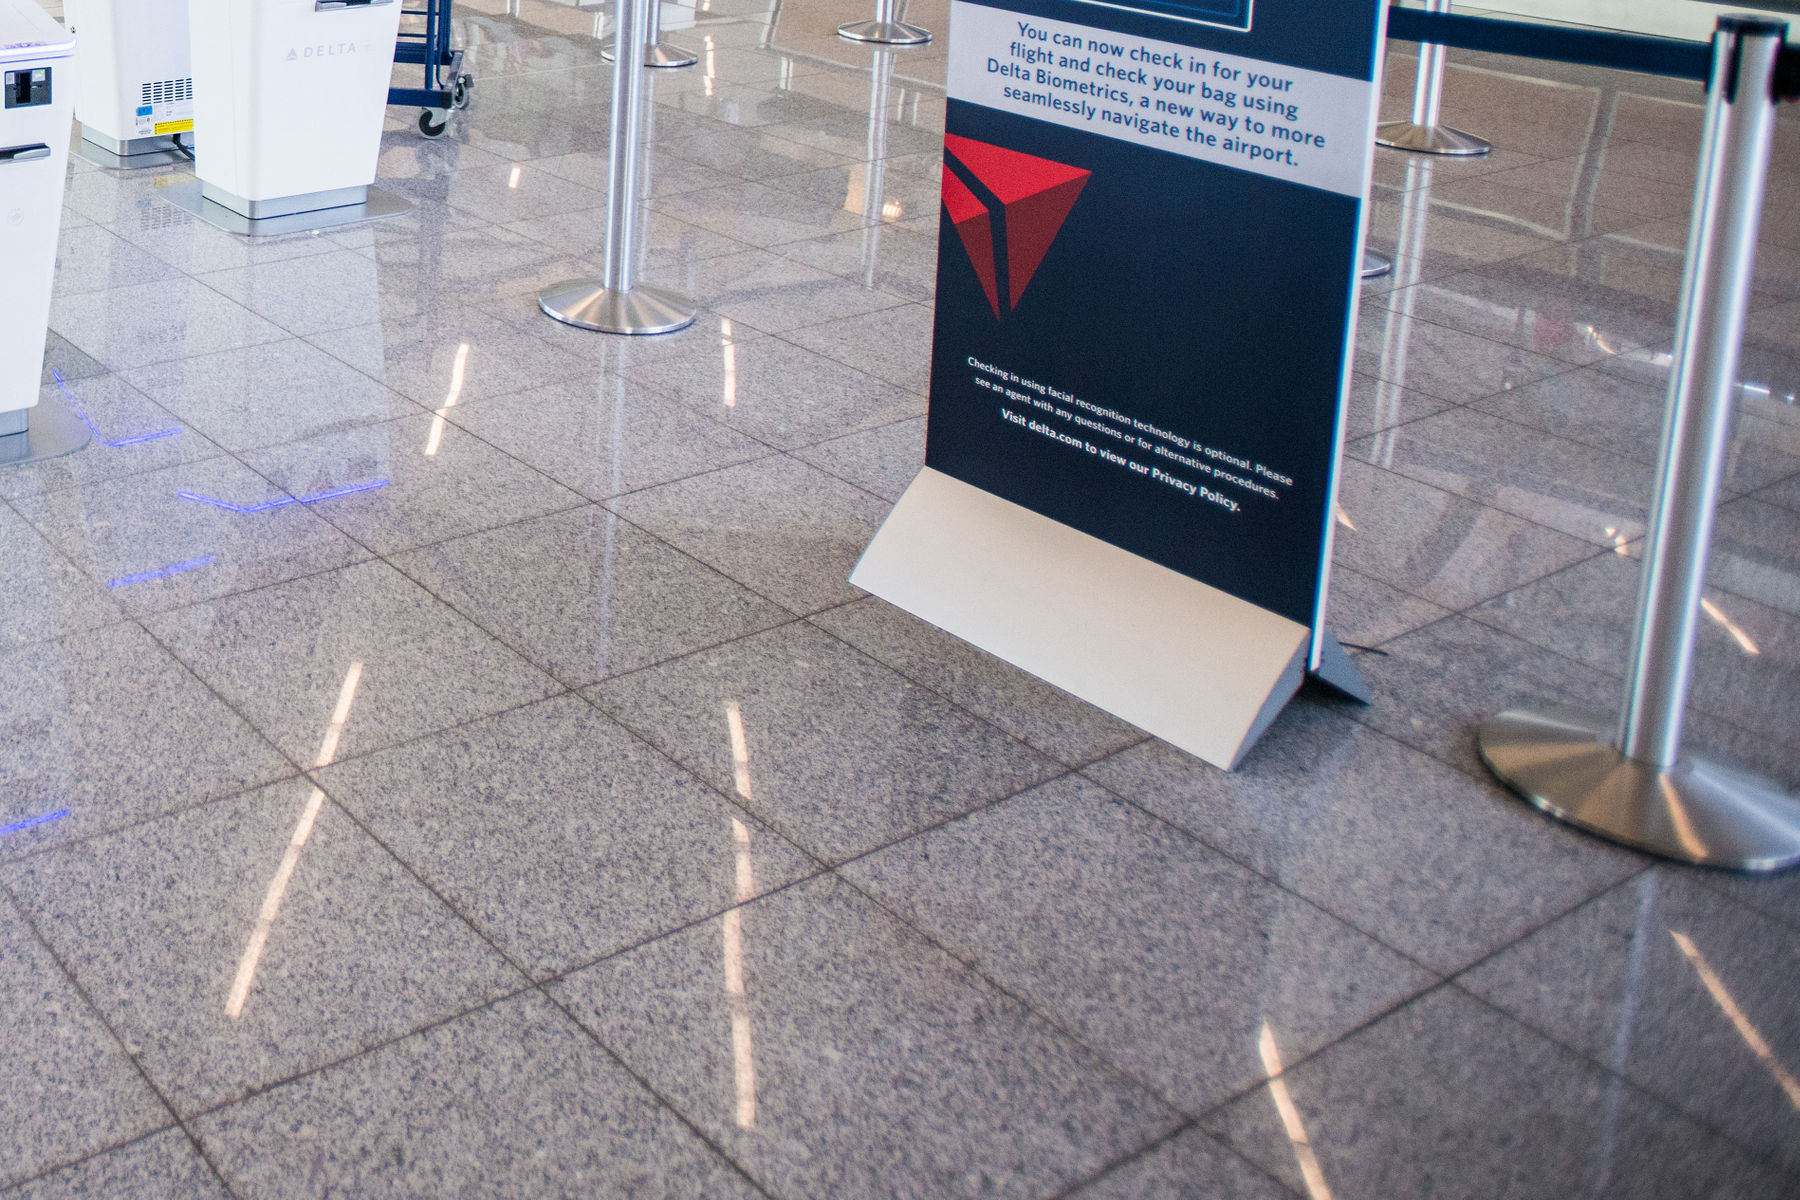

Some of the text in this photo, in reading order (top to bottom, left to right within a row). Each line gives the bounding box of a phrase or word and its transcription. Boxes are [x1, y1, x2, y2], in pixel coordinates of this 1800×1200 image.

[303, 42, 357, 59] DELTA
[1010, 41, 1300, 122] flight and check your bag using
[1017, 20, 1294, 92] You can now check in for your
[986, 57, 1327, 149] Delta Biometrics, a new way to more
[1003, 85, 1300, 167] seamlessly navigate the airport.
[967, 356, 1295, 487] Checking in using facial recognition technology is optional. Please
[975, 375, 1280, 500] see an agent with any questions or for alternative procedures.
[1001, 407, 1241, 513] Visit delta.com to view our Privacy Policy.
